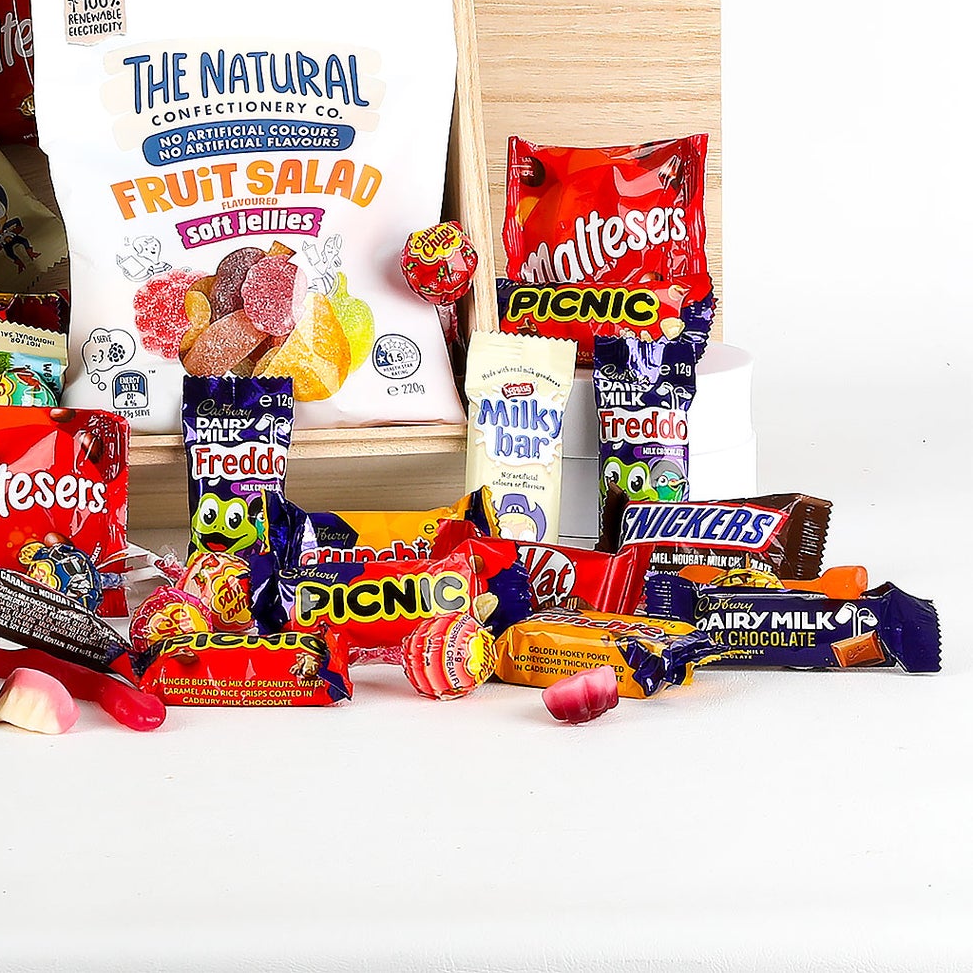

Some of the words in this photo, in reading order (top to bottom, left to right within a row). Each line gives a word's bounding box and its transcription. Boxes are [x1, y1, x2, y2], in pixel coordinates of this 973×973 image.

[68, 8, 122, 25] RENEWABLE
[68, 21, 123, 37] ELECTRICITY
[123, 51, 190, 115] THE
[200, 49, 370, 107] NATURAL
[151, 101, 307, 127] CONFECTIONERY
[315, 106, 343, 120] CO.
[159, 134, 182, 148] NO
[186, 124, 266, 143] ARTIFICIAL
[269, 124, 338, 138] COLOURS
[158, 147, 182, 161] NO
[185, 137, 263, 156] ARTIFICIAL
[267, 136, 340, 148] FLAVOURS
[246, 159, 383, 208] SALAD
[221, 197, 278, 210] FLAVOURED
[187, 217, 233, 245] soft
[237, 210, 315, 233] jellies
[509, 290, 657, 324] PICNIC
[387, 351, 404, 364] 1.5
[674, 362, 692, 377] 12g
[402, 382, 425, 395] 220g
[598, 379, 656, 393] DAIRY
[276, 393, 294, 410] 12g
[599, 391, 646, 407] MILK
[195, 398, 253, 419] Cadbury
[195, 417, 257, 430] DAIRY
[477, 398, 565, 440] Milky
[599, 411, 688, 441] Freddo
[195, 429, 244, 443] MILK
[494, 426, 550, 460] bar
[195, 446, 285, 476] Freddo
[624, 506, 769, 545] SNICKERS
[707, 555, 728, 567] MILK
[297, 573, 469, 623] PICNIC
[696, 611, 770, 632] DAIRY
[771, 610, 837, 631] MILK
[728, 630, 816, 648] CHOCOLATE
[528, 645, 559, 656] GOLDEN
[560, 650, 585, 659] HOKEY
[586, 653, 611, 663] POKEY
[513, 654, 562, 666] HONEYCOMB
[563, 659, 594, 669] THICKLY
[594, 663, 625, 673] COTED
[524, 664, 559, 675] CADBURY
[191, 678, 227, 688] BUSTING
[228, 679, 244, 688] MIX
[244, 679, 256, 687] OF
[163, 687, 200, 696] CARAMEL
[200, 688, 219, 697] AND
[220, 689, 239, 698] RICE
[240, 689, 268, 698] CRISPS
[269, 689, 302, 697] COATED
[303, 689, 313, 697] IN
[182, 696, 221, 706] CADBURY
[222, 698, 242, 706] MILK
[242, 698, 293, 707] CHOCOLATE
